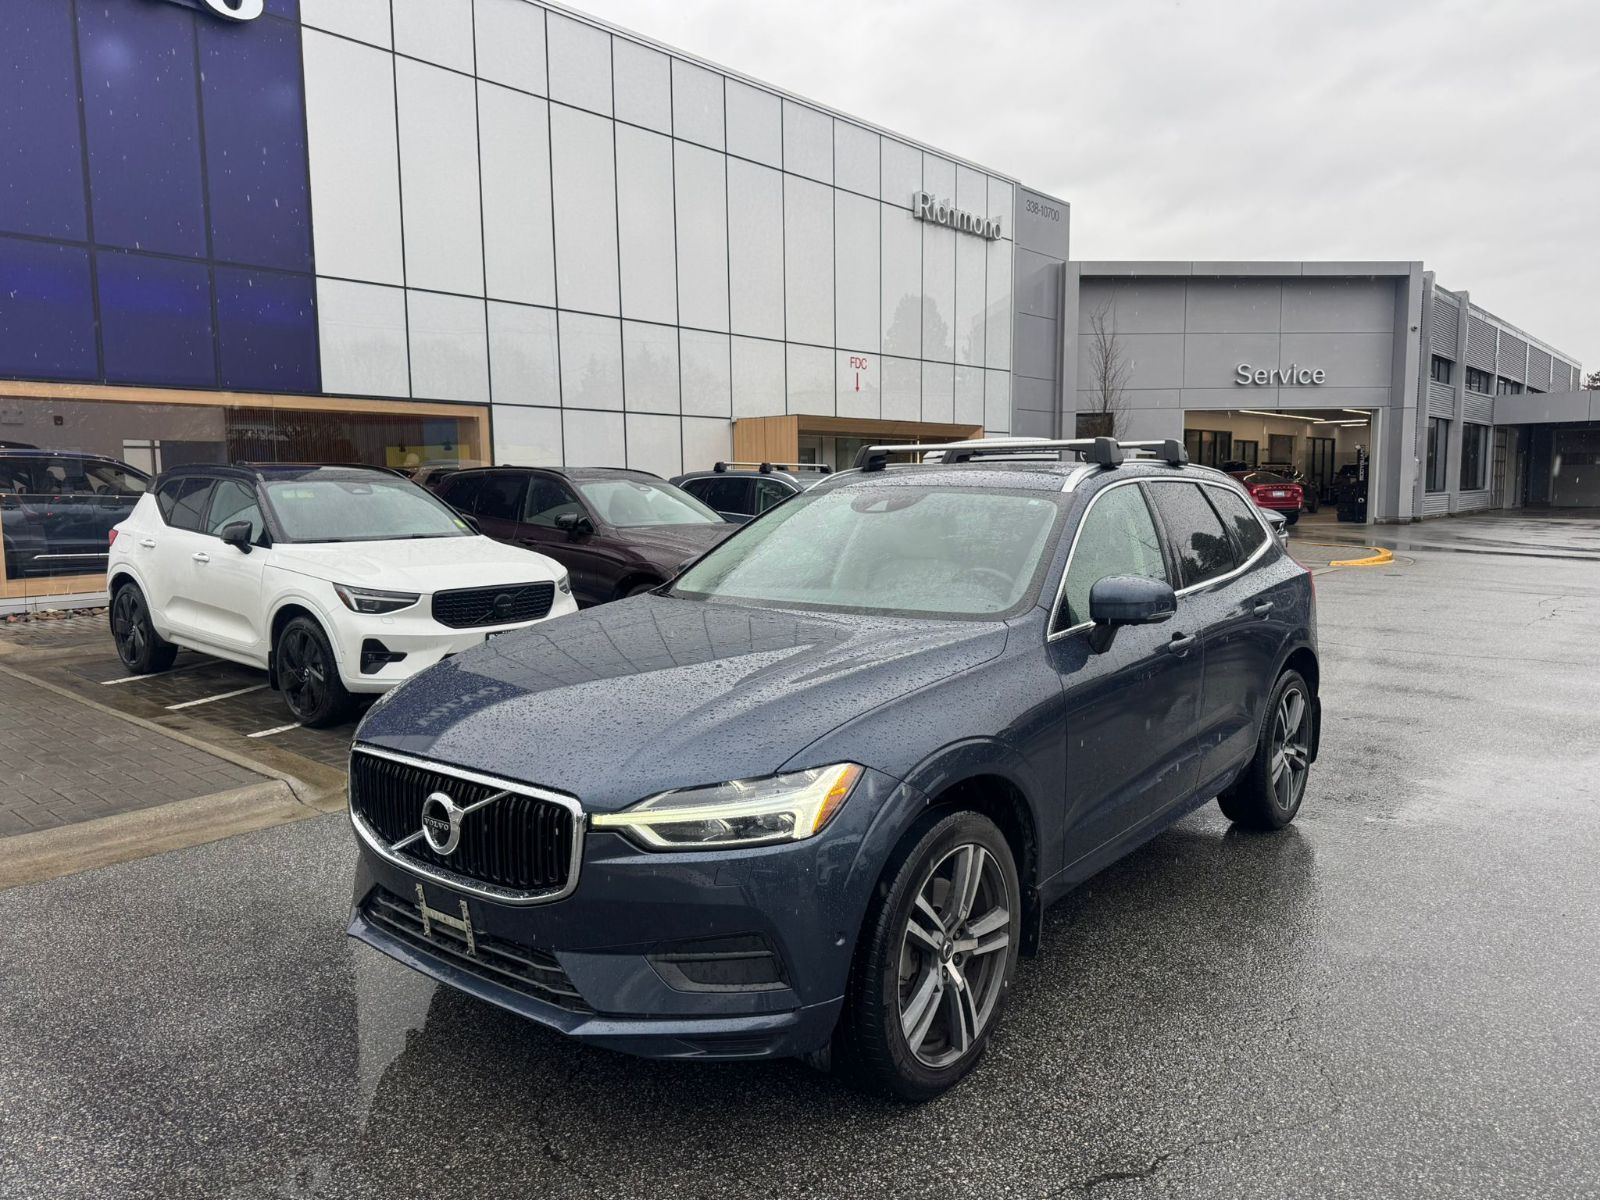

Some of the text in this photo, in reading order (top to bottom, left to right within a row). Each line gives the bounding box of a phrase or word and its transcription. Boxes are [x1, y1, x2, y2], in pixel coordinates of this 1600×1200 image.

[914, 191, 1002, 240] Richmond
[1025, 199, 1060, 222] 338-10700
[850, 356, 868, 370] FDC
[1236, 363, 1326, 385] Service
[423, 817, 449, 831] VOLVO
